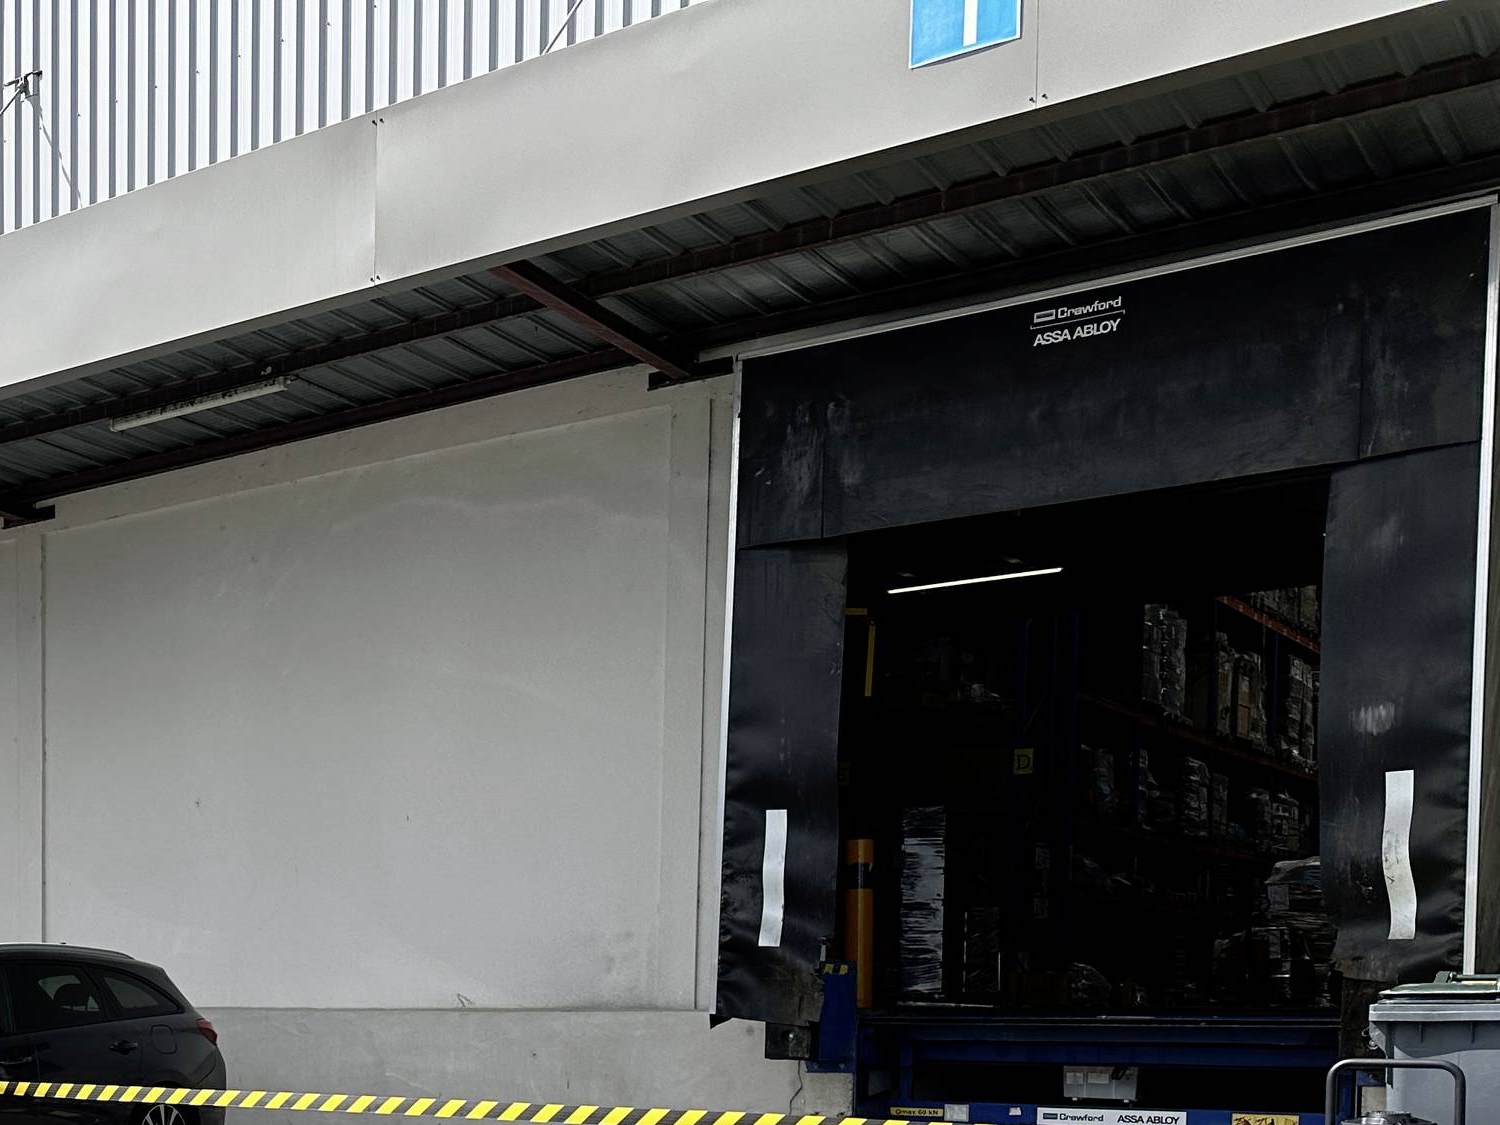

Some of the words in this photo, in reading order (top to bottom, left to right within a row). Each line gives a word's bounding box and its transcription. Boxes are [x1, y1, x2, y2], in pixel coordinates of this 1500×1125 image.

[1058, 296, 1122, 319] Crawford
[1033, 328, 1071, 347] ASSA
[1073, 318, 1121, 340] ABLOY
[1059, 1113, 1104, 1122] Crawford
[1117, 1114, 1144, 1124] ASSA
[1146, 1116, 1180, 1125] ABLOY
